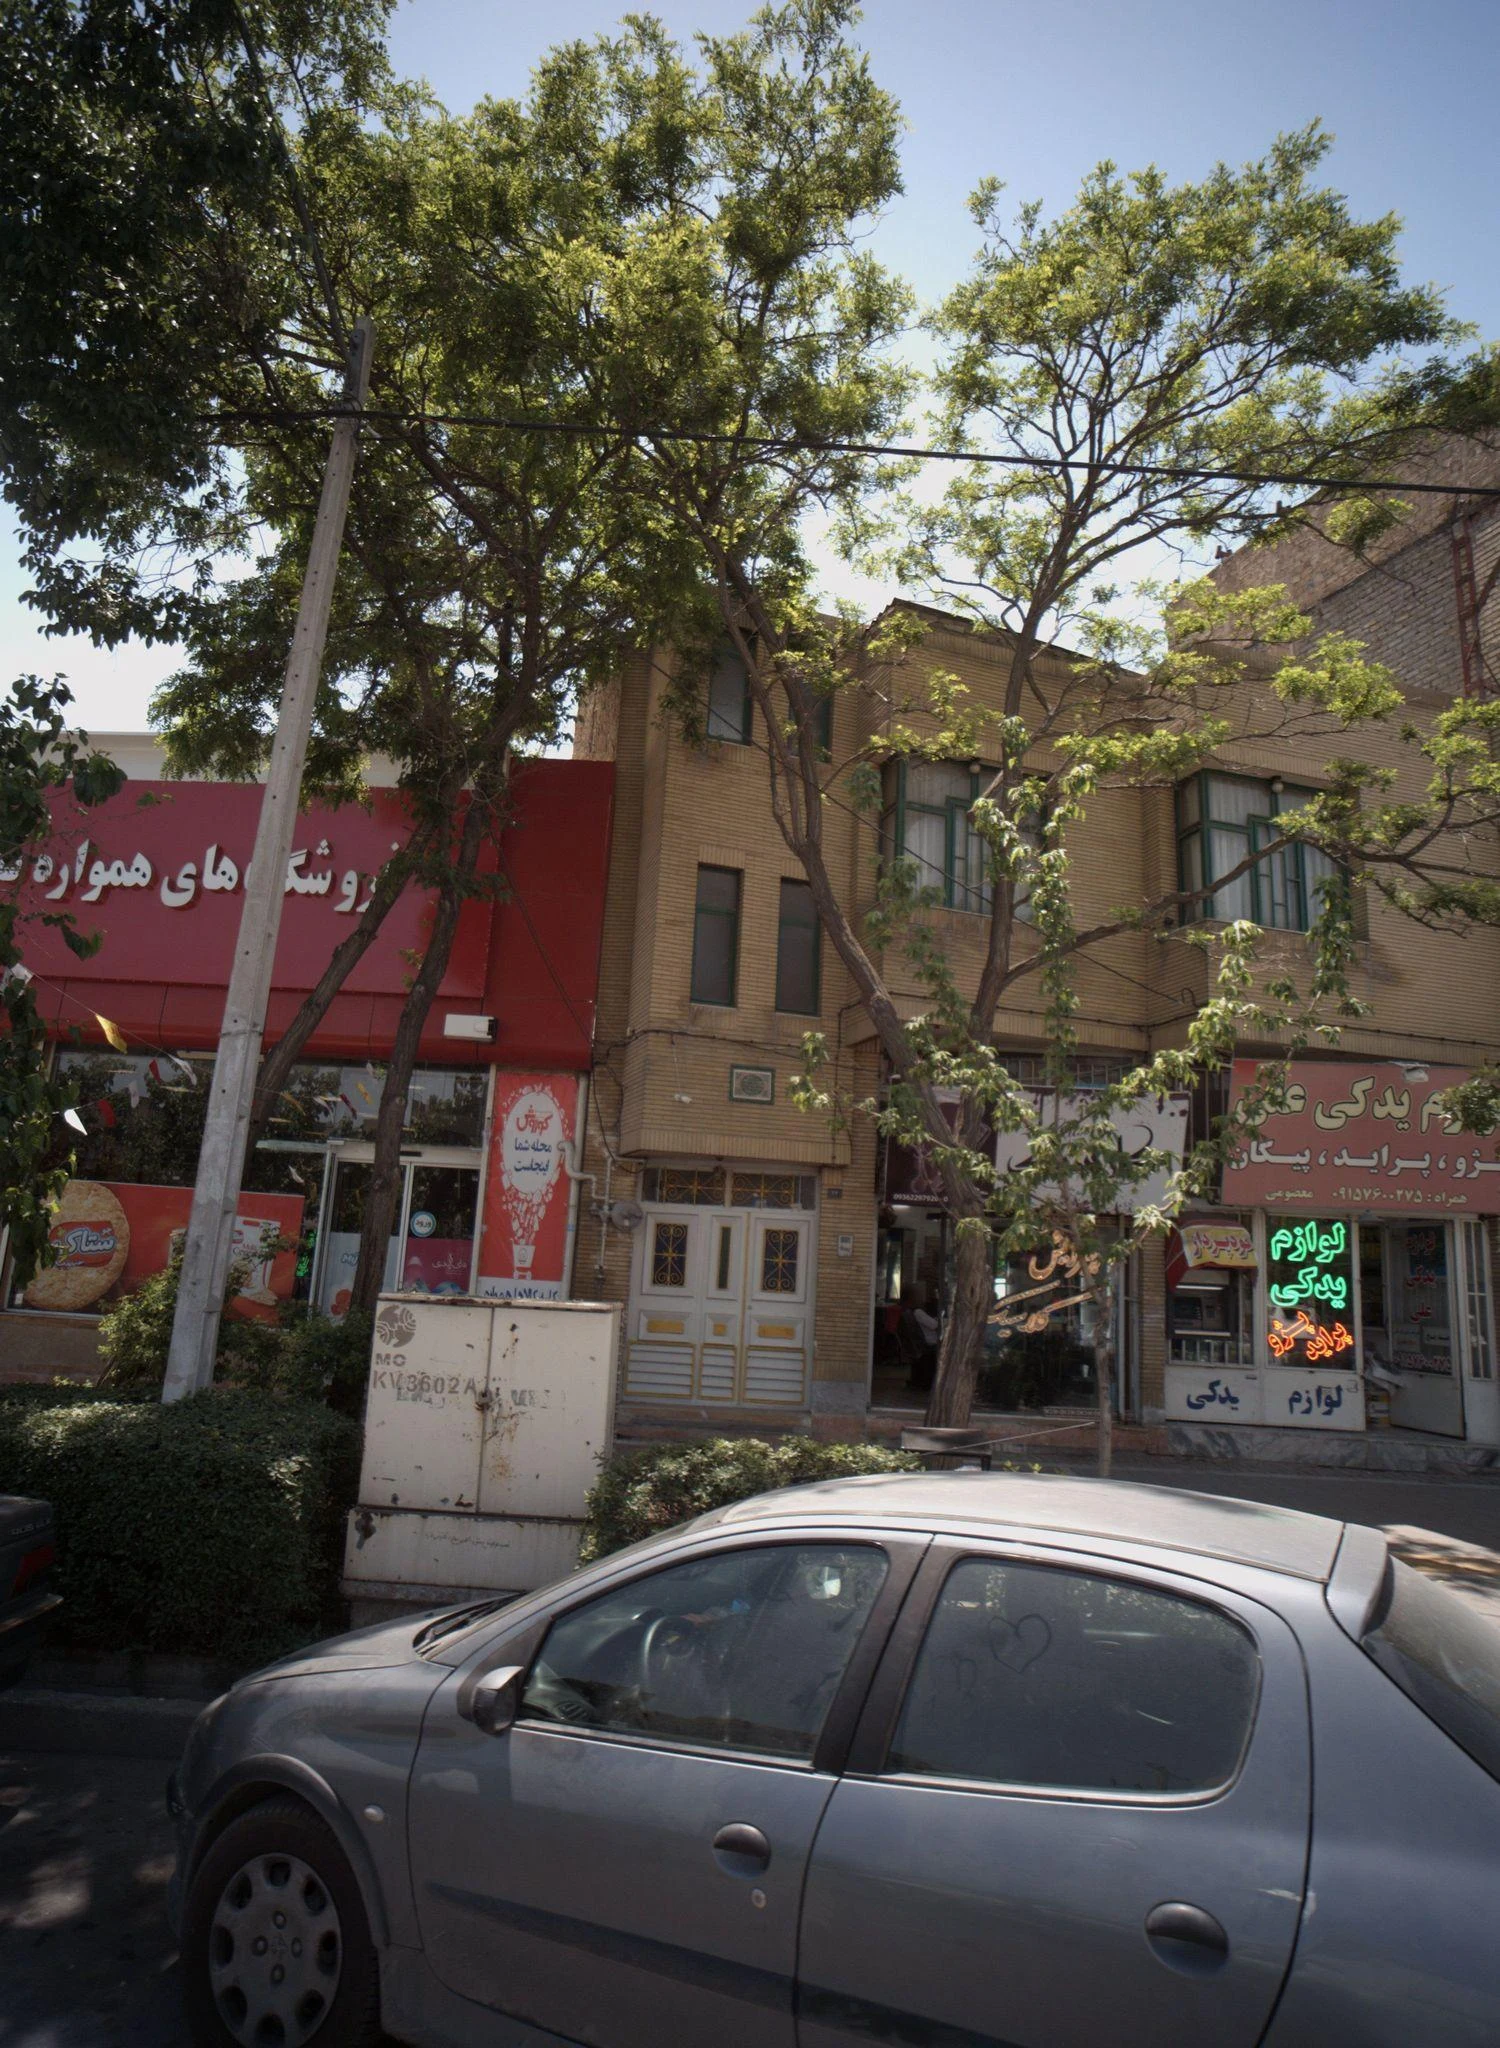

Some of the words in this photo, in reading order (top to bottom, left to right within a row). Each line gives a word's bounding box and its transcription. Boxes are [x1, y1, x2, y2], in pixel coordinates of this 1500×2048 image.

[32, 837, 152, 902] همواره
[160, 843, 239, 908] های
[516, 1104, 553, 1137] کوروش
[1314, 1076, 1411, 1131] یدکی
[514, 1137, 530, 1152] شما
[531, 1139, 552, 1154] محله
[513, 1158, 550, 1178] اینجاست
[1270, 1221, 1346, 1262] لوازم
[1270, 1266, 1347, 1309] یدکی
[1306, 1323, 1354, 1360] پراید
[1186, 1380, 1240, 1411] یدکی
[1287, 1384, 1343, 1415] لوازم
